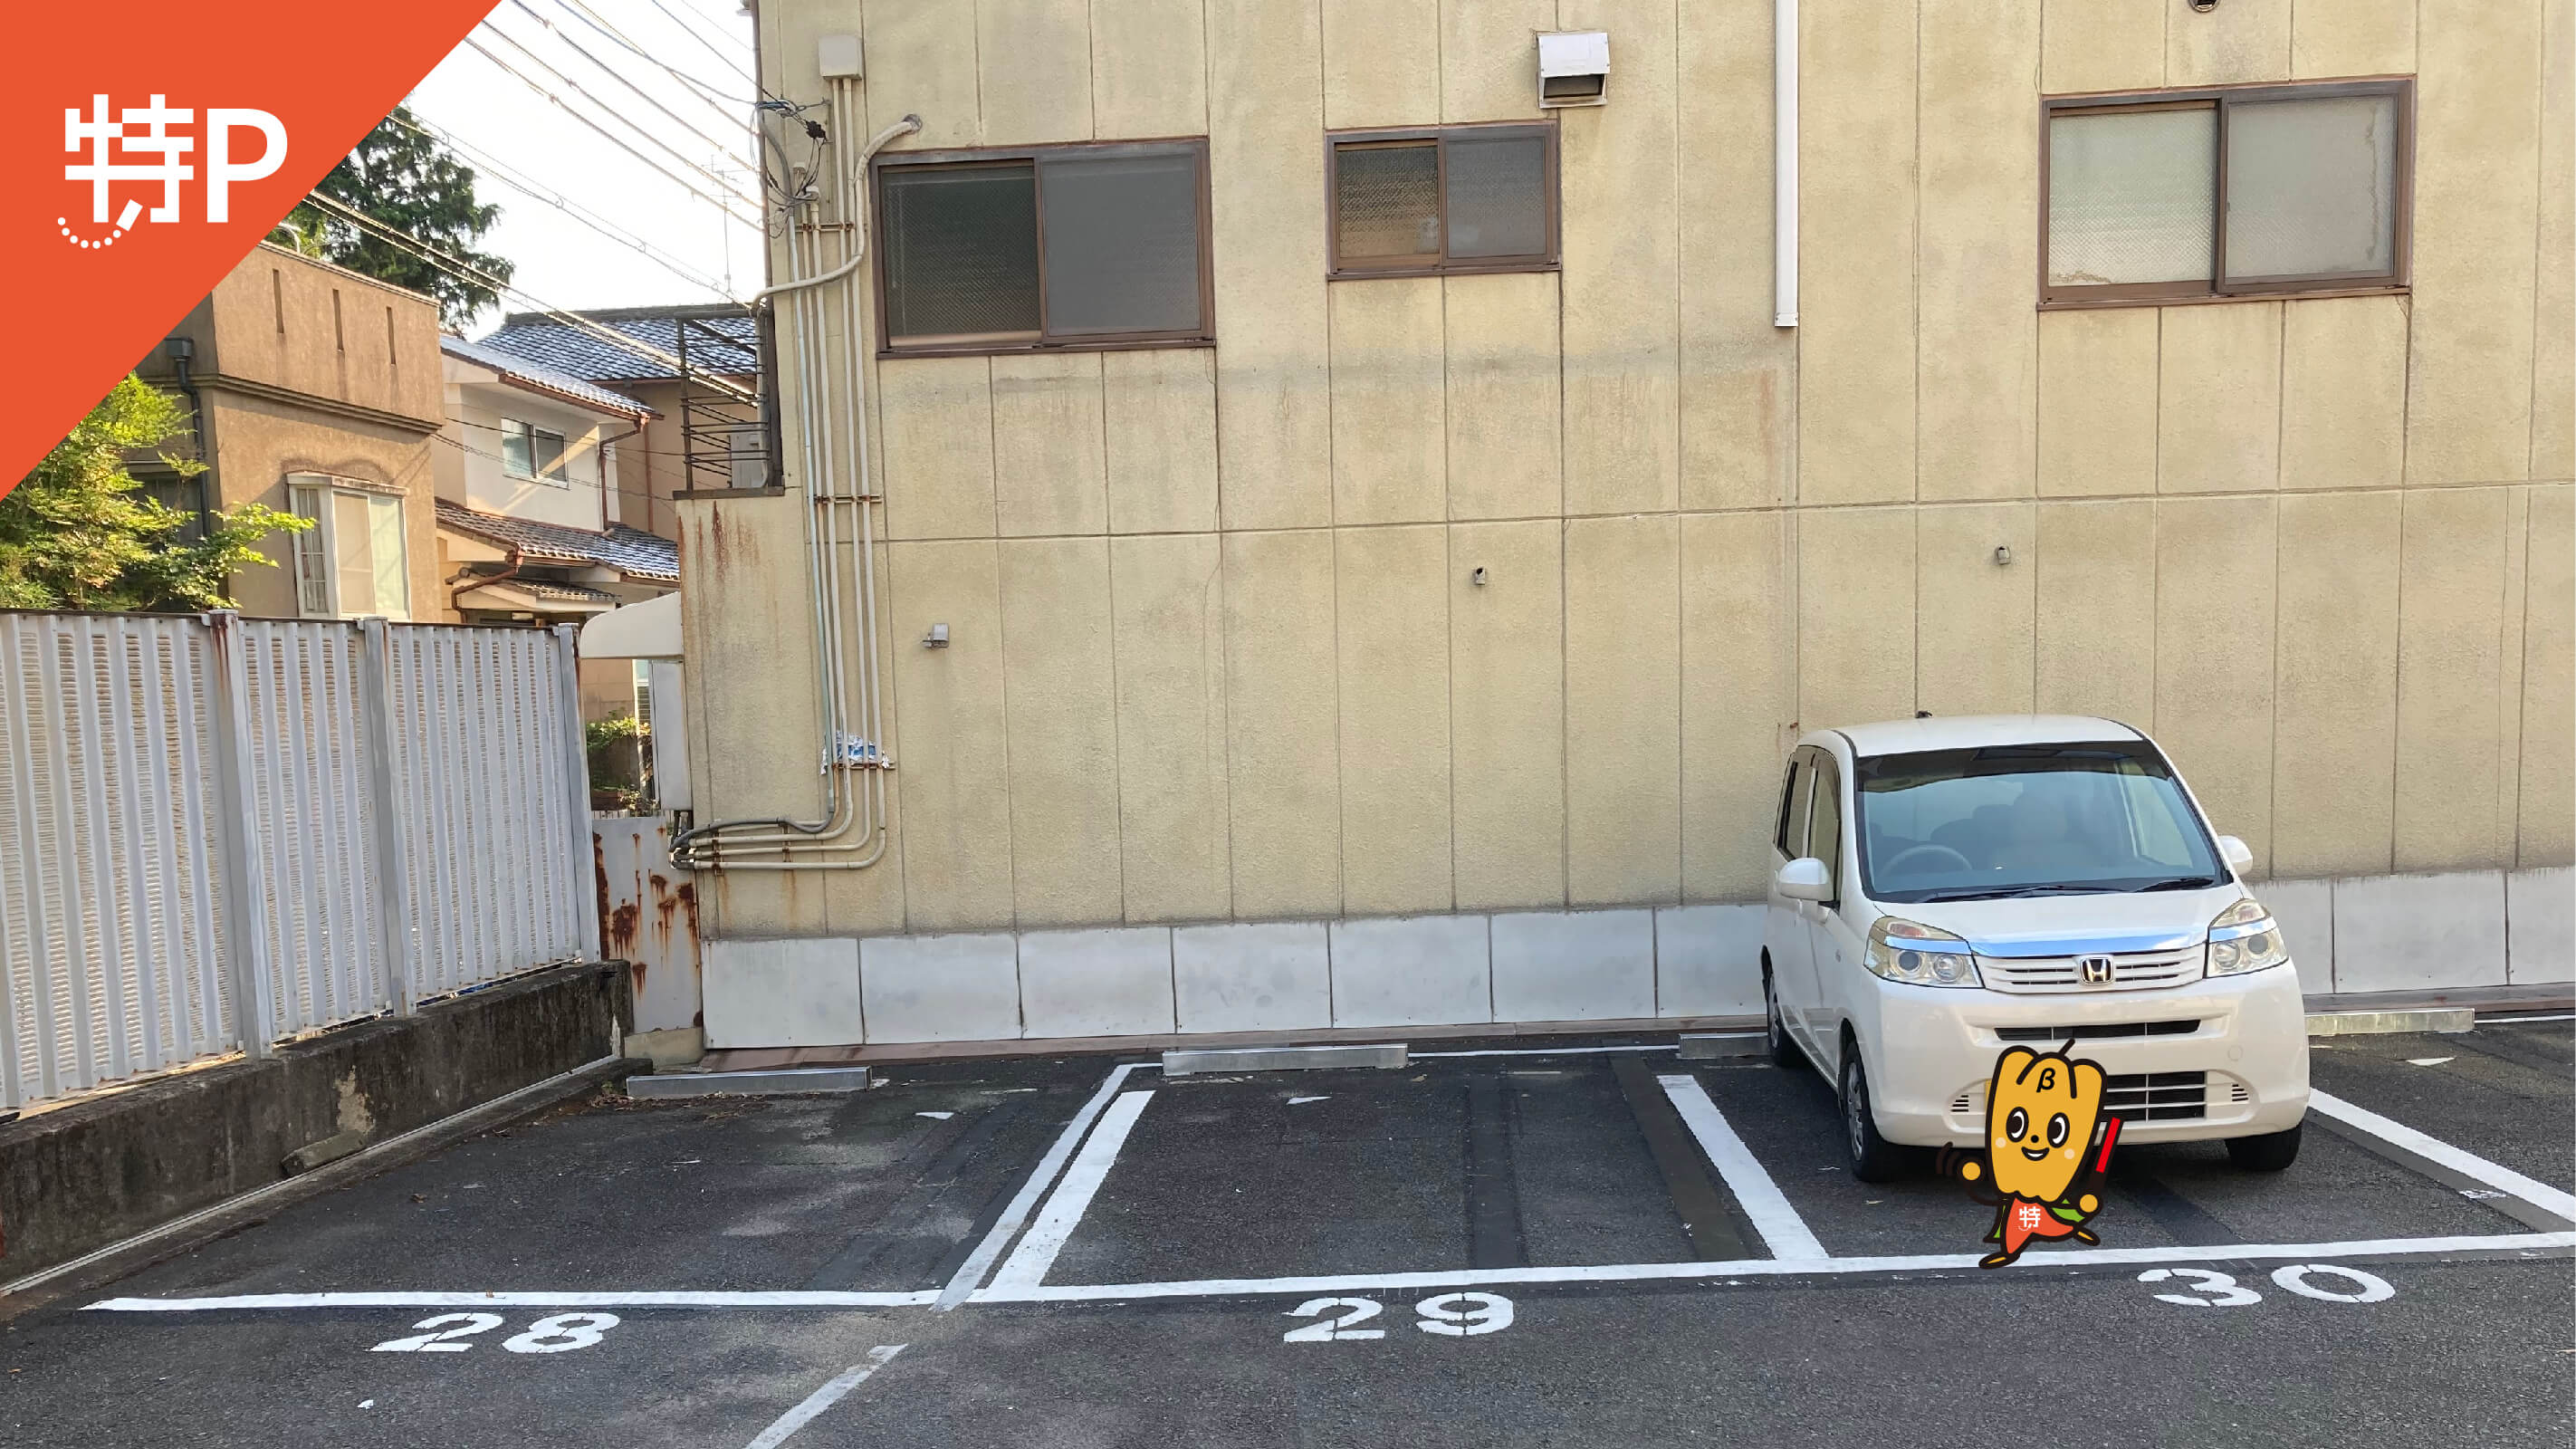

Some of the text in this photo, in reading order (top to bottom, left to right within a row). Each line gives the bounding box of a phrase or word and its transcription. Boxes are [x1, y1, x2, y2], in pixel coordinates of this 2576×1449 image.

[2137, 1264, 2396, 1307] 30
[369, 1312, 620, 1353] 28
[1282, 1291, 1514, 1342] 29
